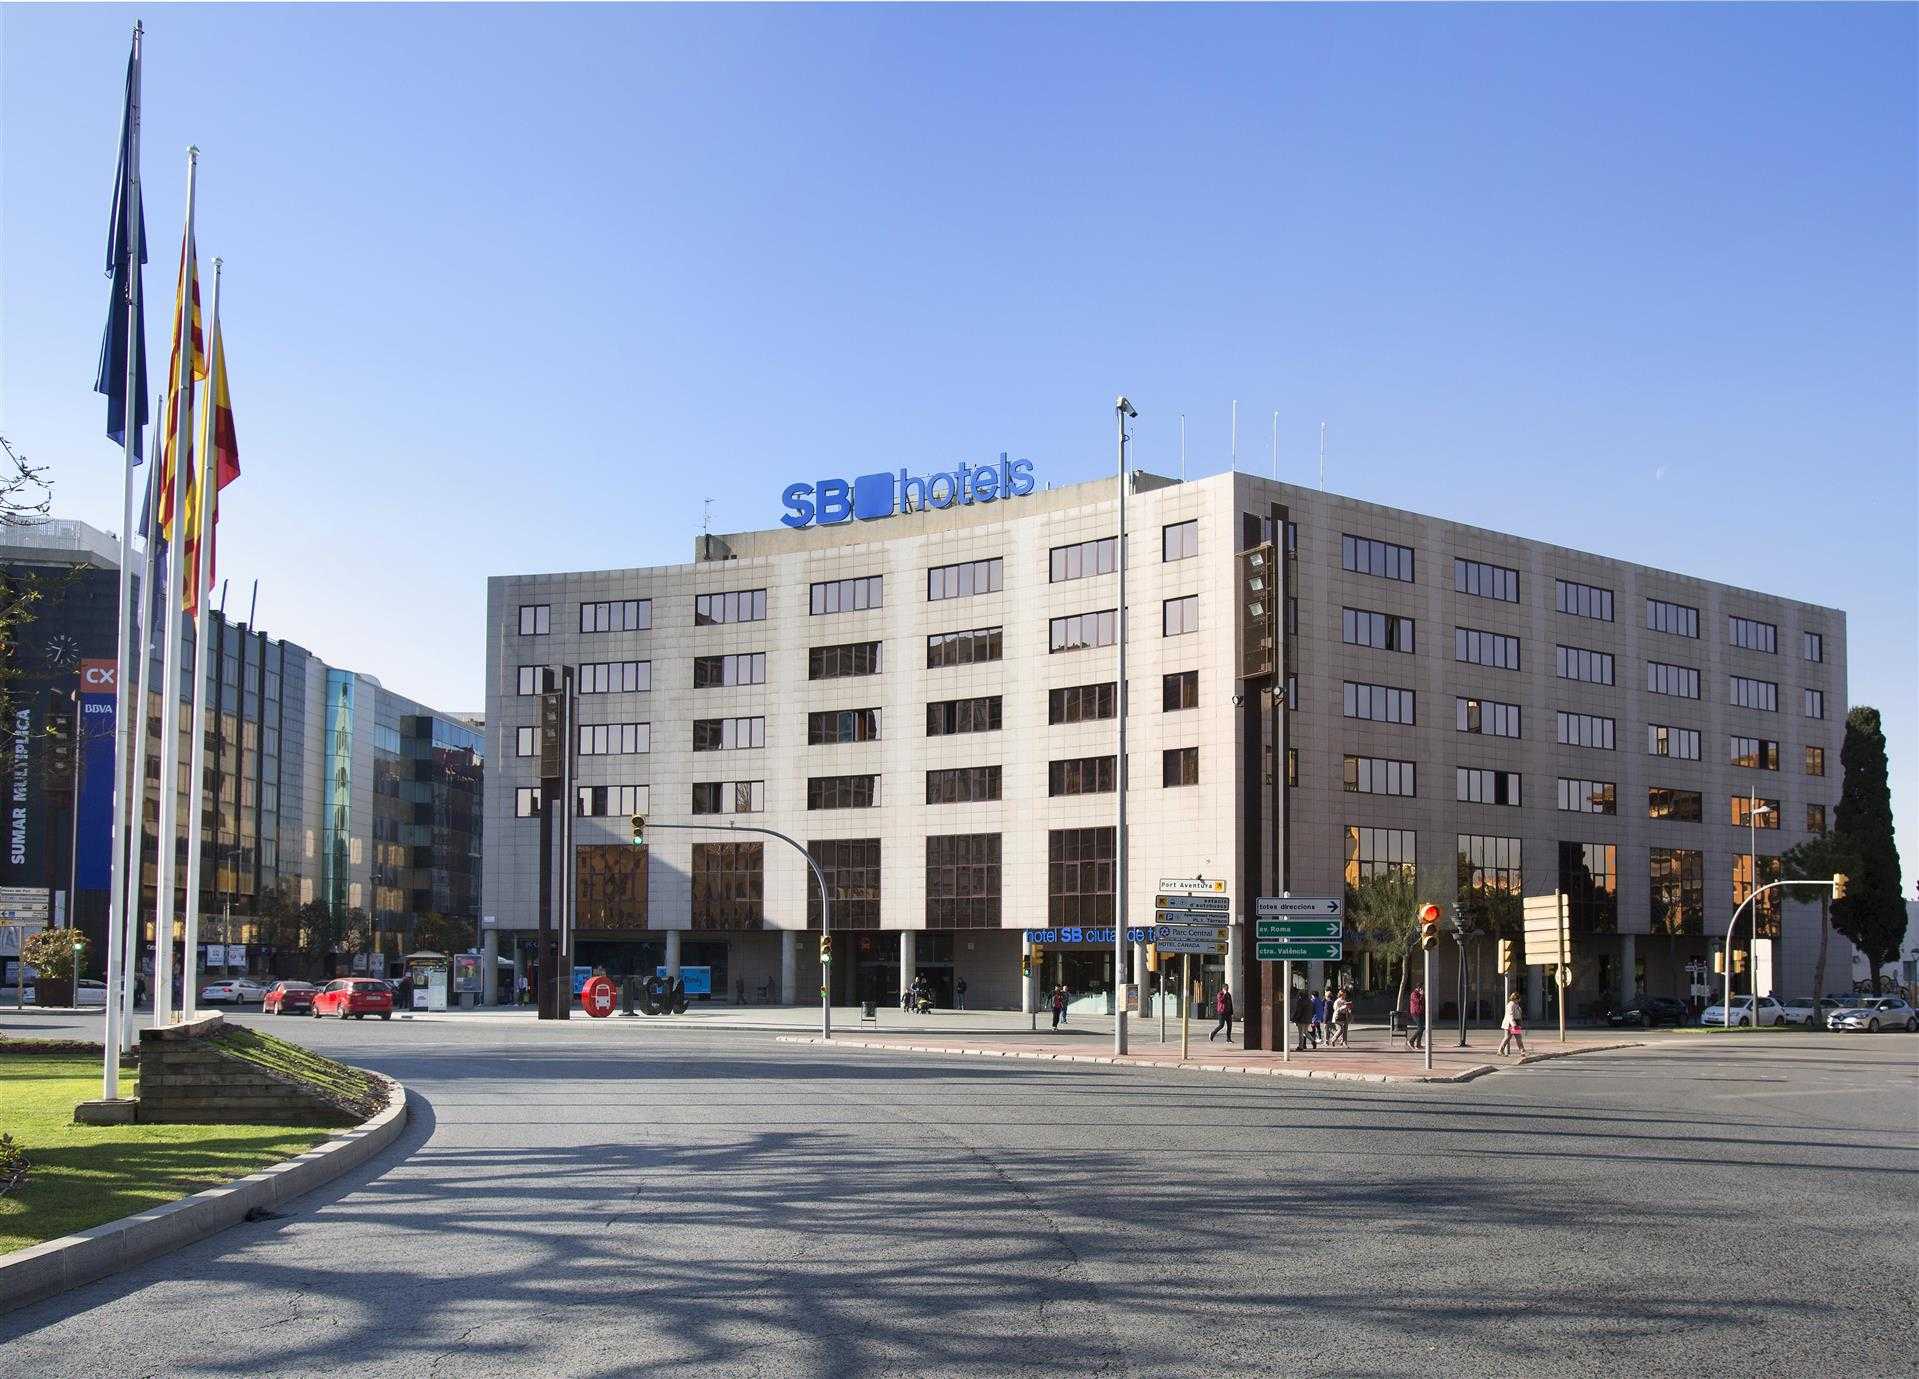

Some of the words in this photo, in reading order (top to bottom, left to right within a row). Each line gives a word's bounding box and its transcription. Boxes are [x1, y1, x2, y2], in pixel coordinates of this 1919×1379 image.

[780, 478, 850, 528] SB
[900, 451, 1035, 513] hotels
[86, 668, 114, 684] CX
[85, 704, 112, 713] BBVA
[11, 807, 27, 865] SUMAR
[1026, 928, 1057, 942] hotel
[1061, 928, 1083, 943] SB
[1085, 928, 1117, 943] ciuta
[1127, 927, 1145, 942] de
[1188, 929, 1213, 937] Central
